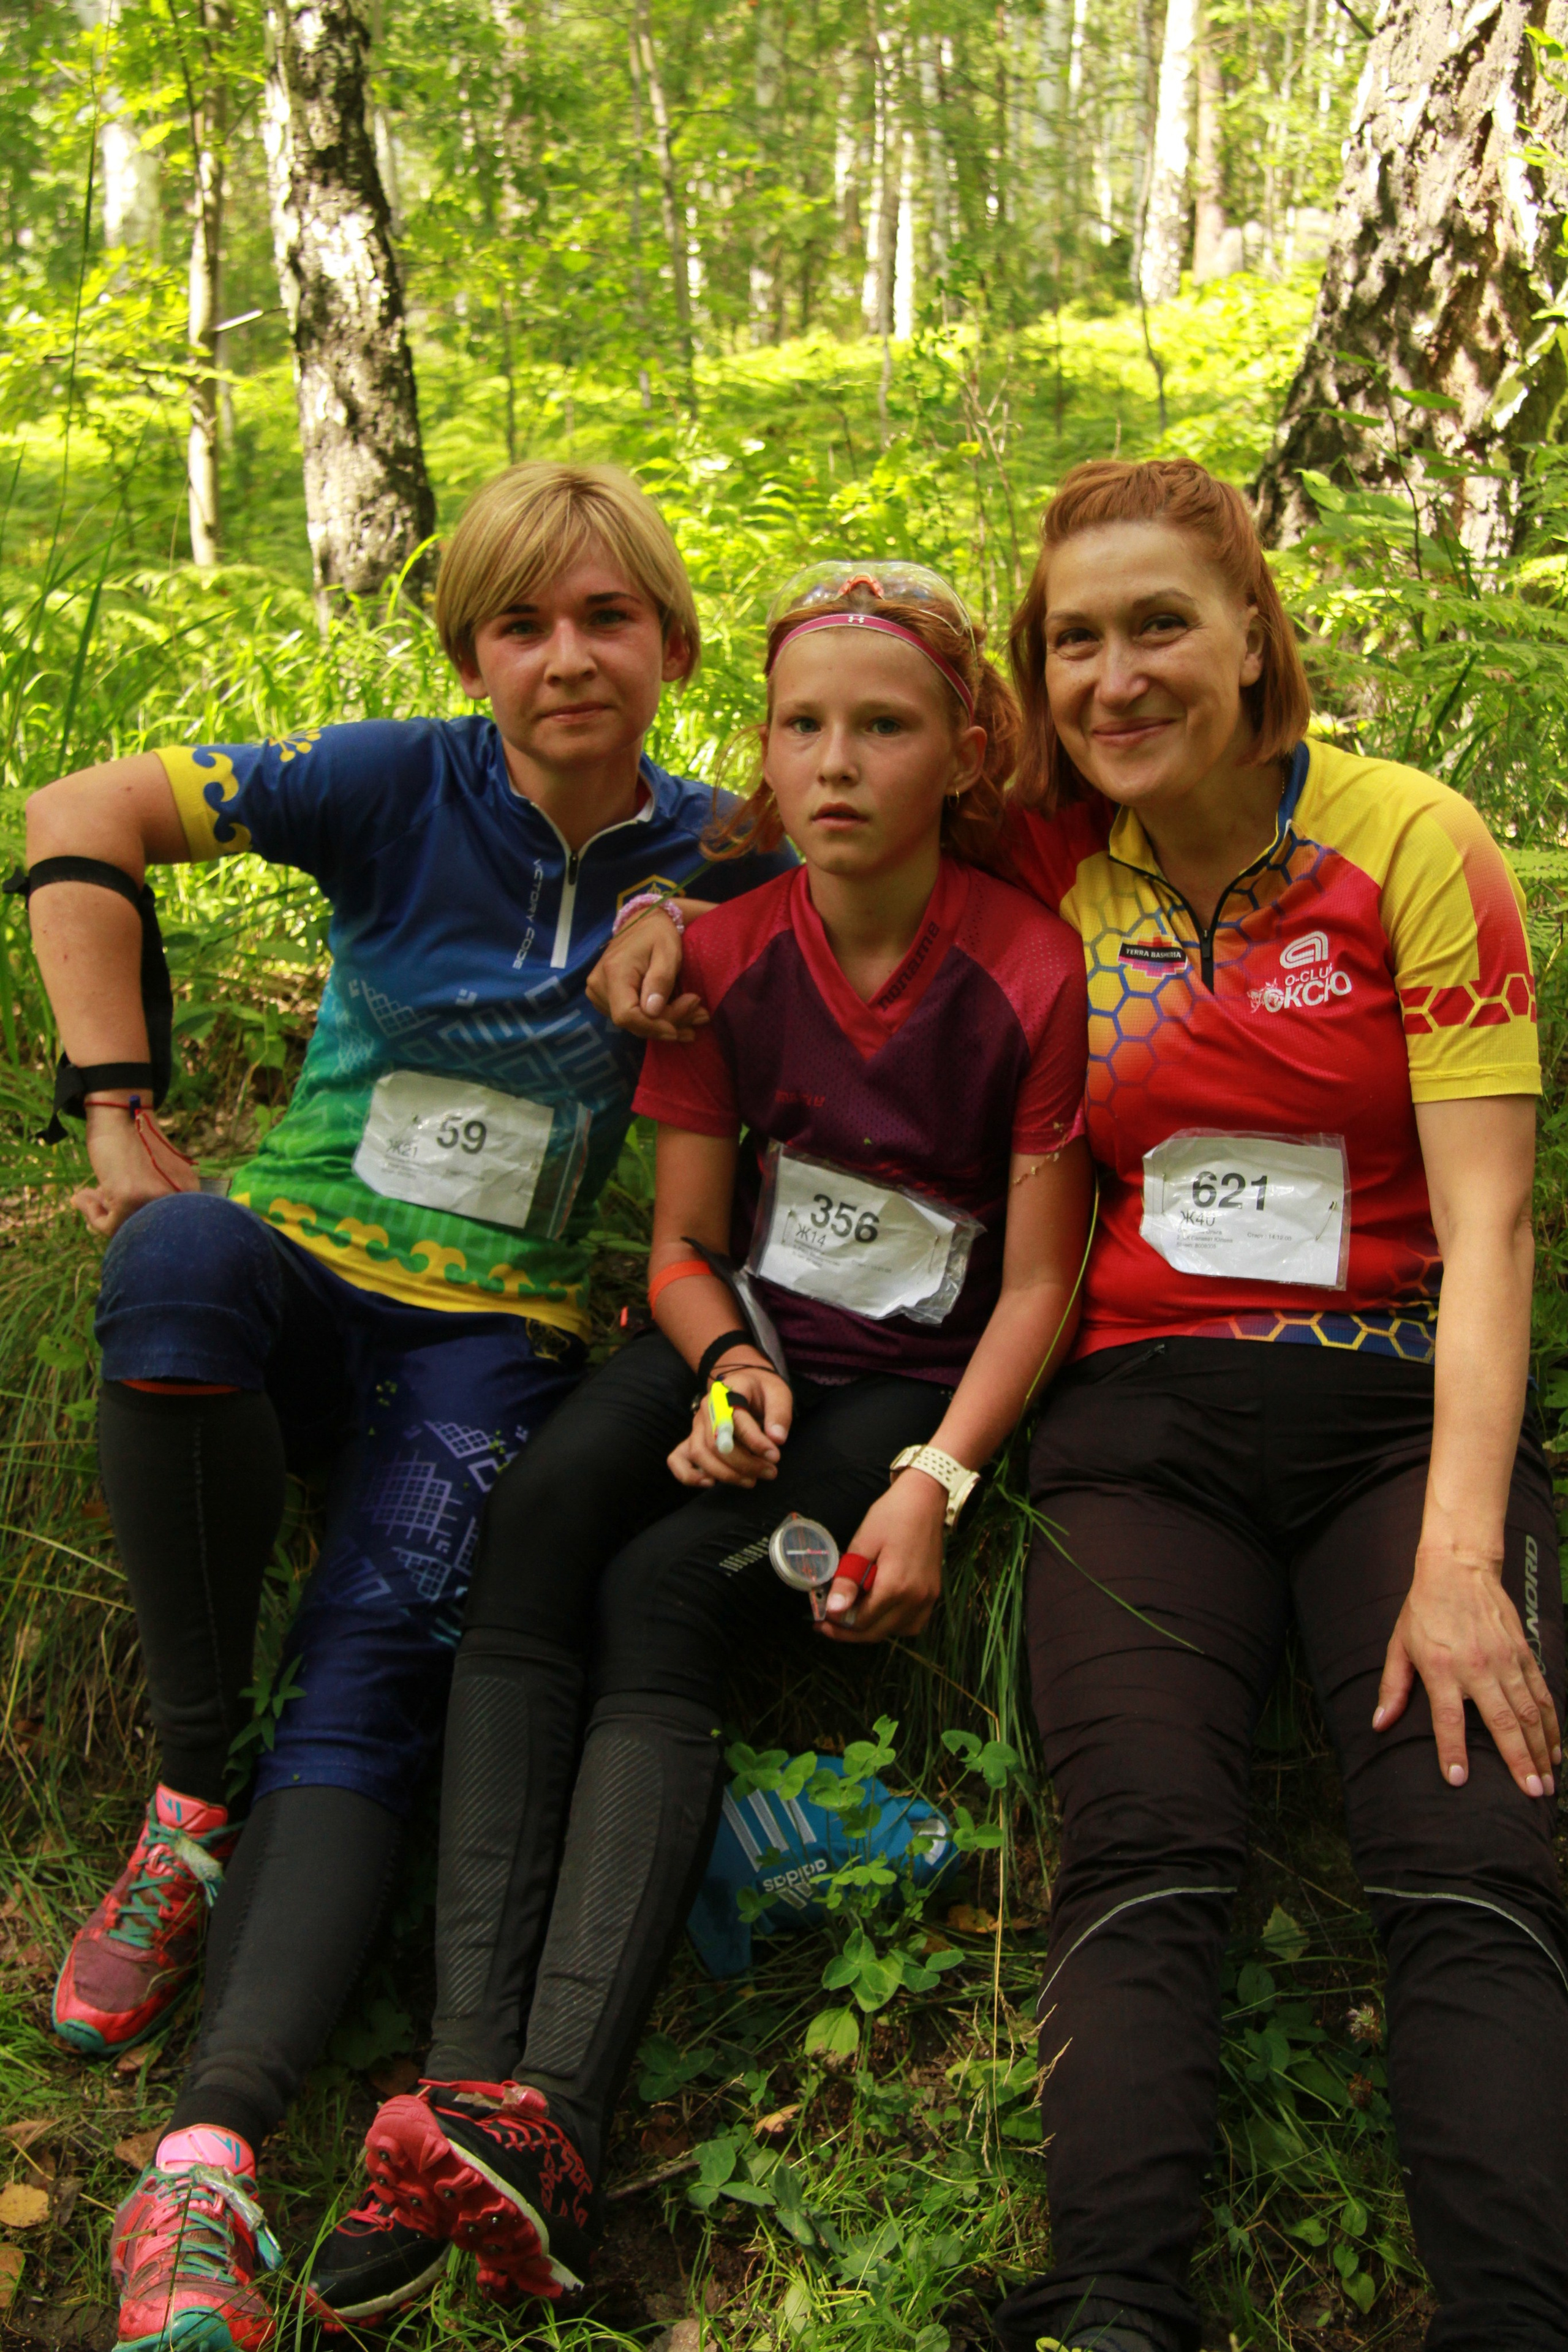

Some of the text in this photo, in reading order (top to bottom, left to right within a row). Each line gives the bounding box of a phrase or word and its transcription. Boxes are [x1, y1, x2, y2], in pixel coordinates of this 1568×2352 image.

[512, 926, 535, 970] CODE
[1126, 948, 1150, 957] TERRA
[436, 1115, 488, 1155] 59
[1192, 1170, 1268, 1212] 621
[796, 1224, 827, 1248] Ж14
[810, 1193, 880, 1245] 356
[763, 1858, 827, 1892] adidas
